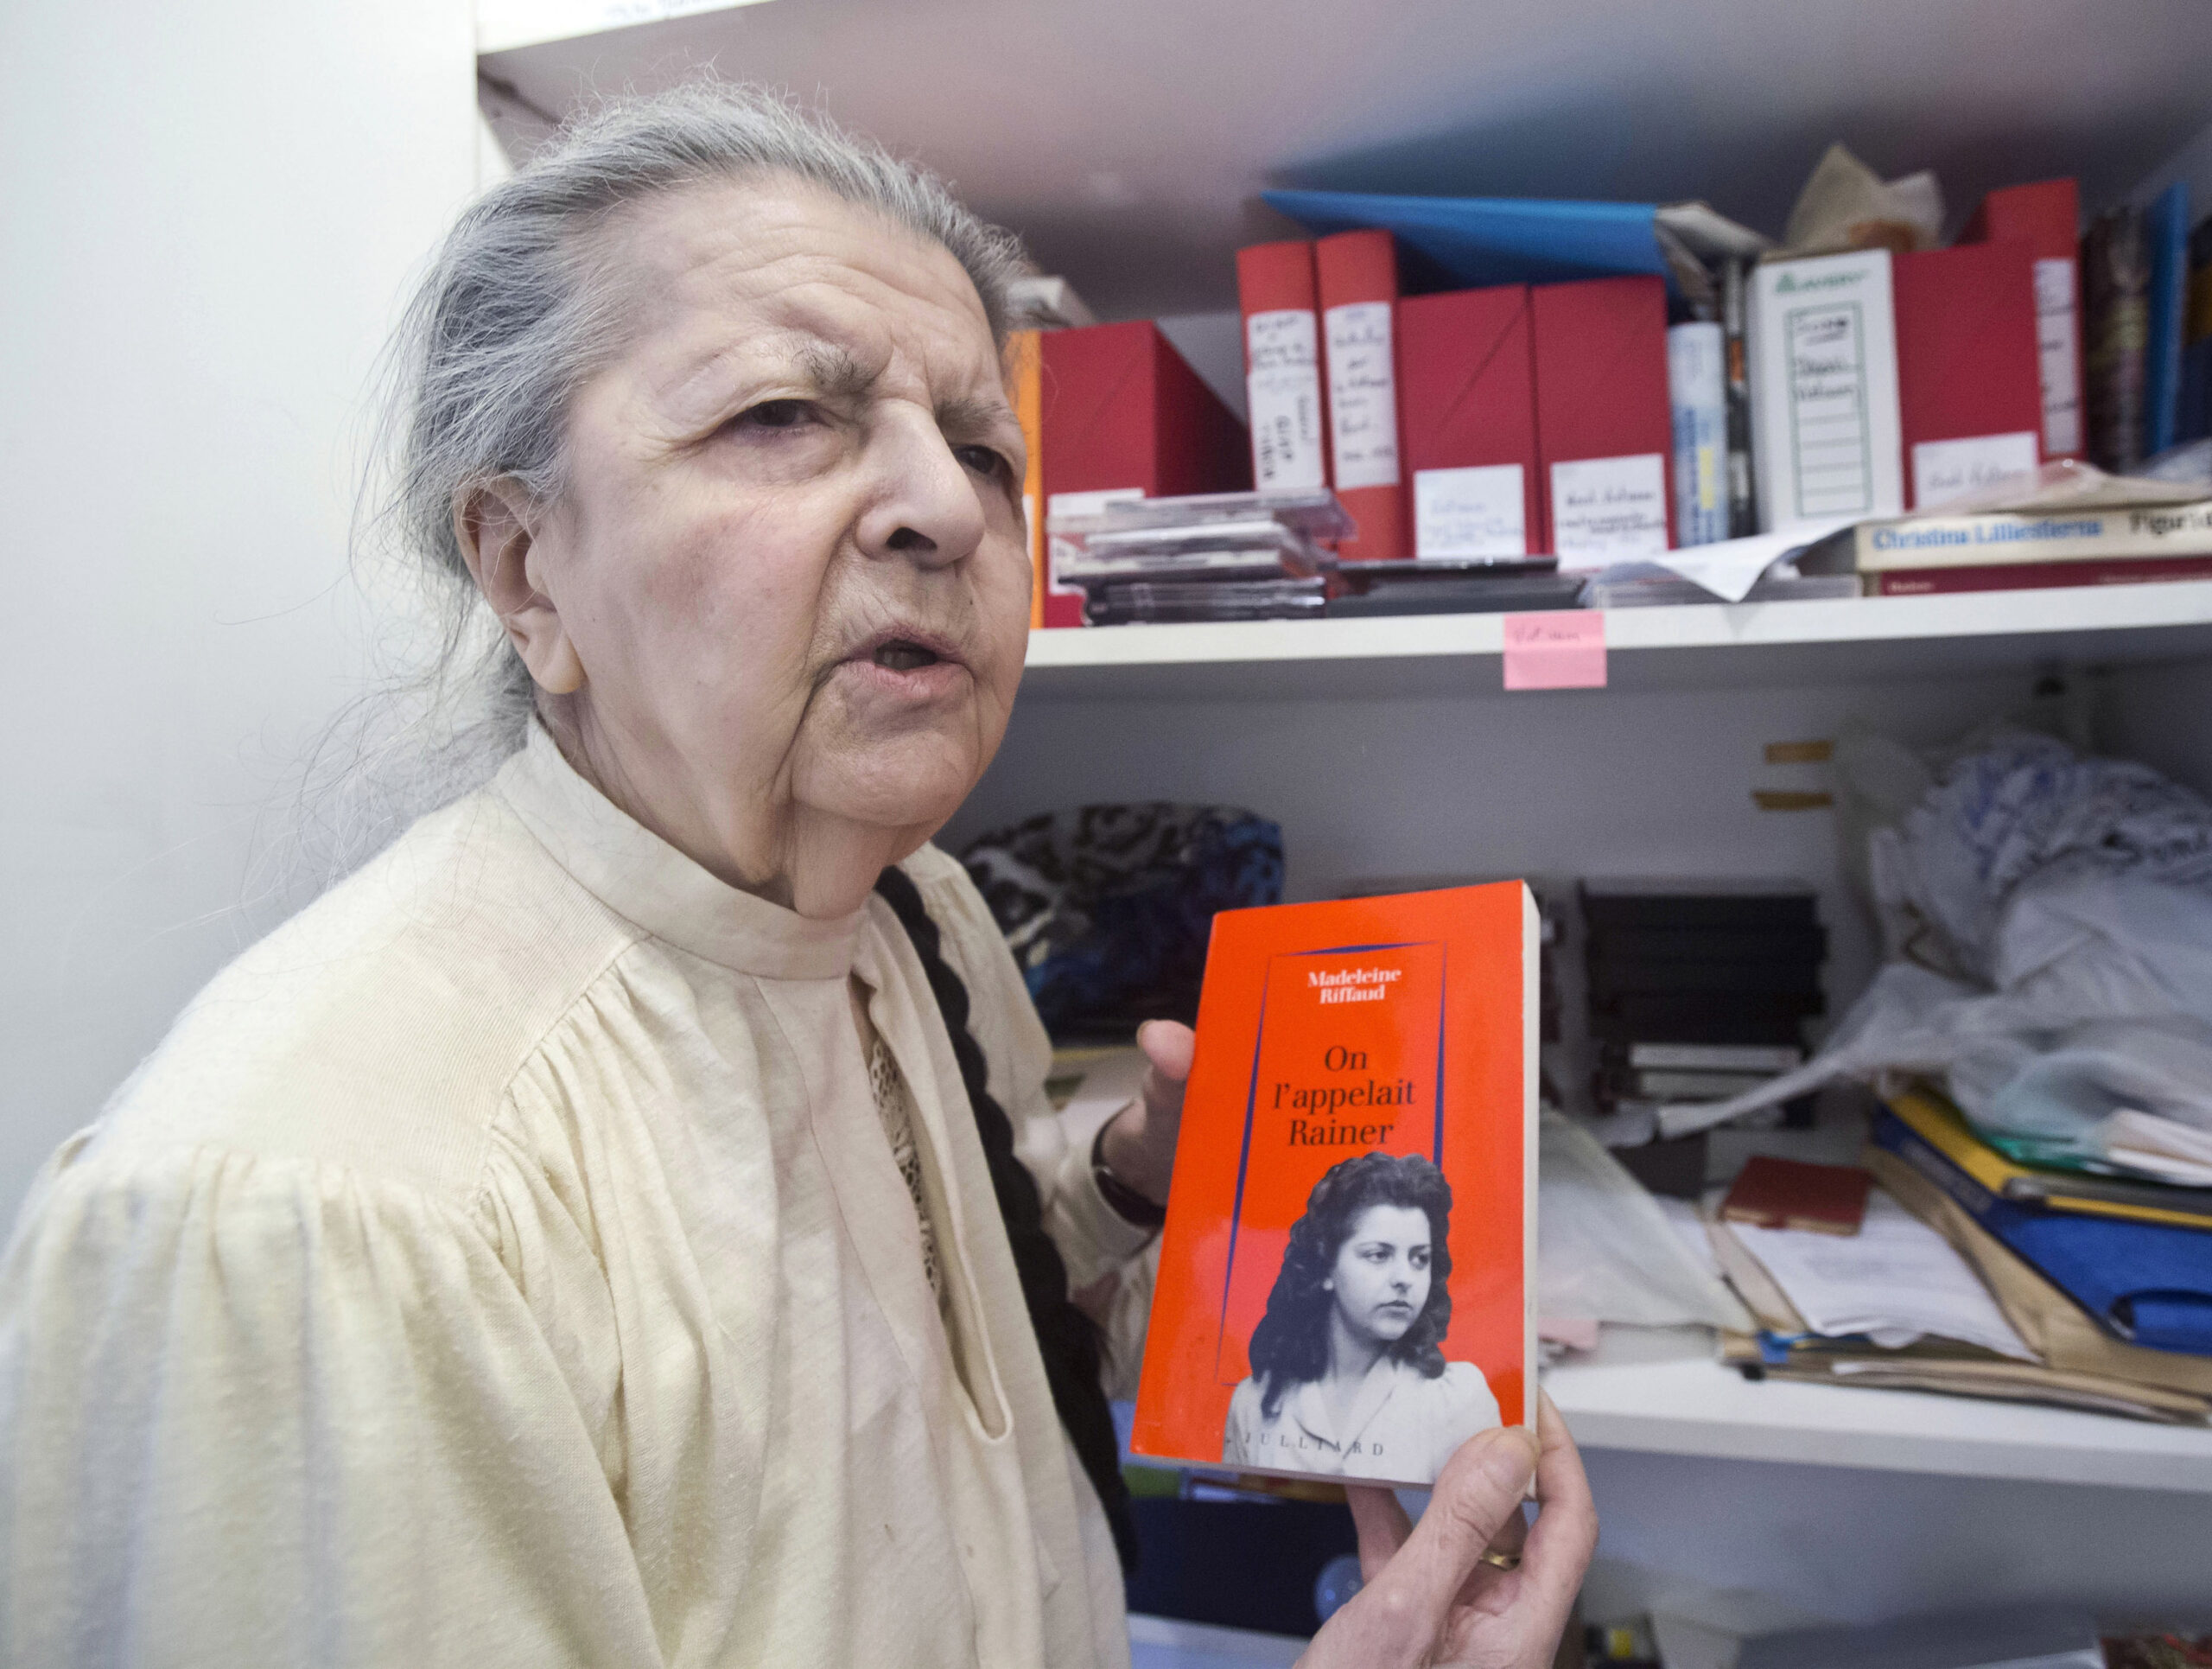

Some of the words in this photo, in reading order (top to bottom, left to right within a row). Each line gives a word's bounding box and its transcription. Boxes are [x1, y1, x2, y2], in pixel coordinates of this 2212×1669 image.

[1872, 526, 1969, 551] Christina
[1307, 967, 1402, 988] Madeleine
[1319, 984, 1386, 1005] Riffaud
[1324, 1045, 1368, 1072] On
[1287, 1118, 1395, 1146] Rainer
